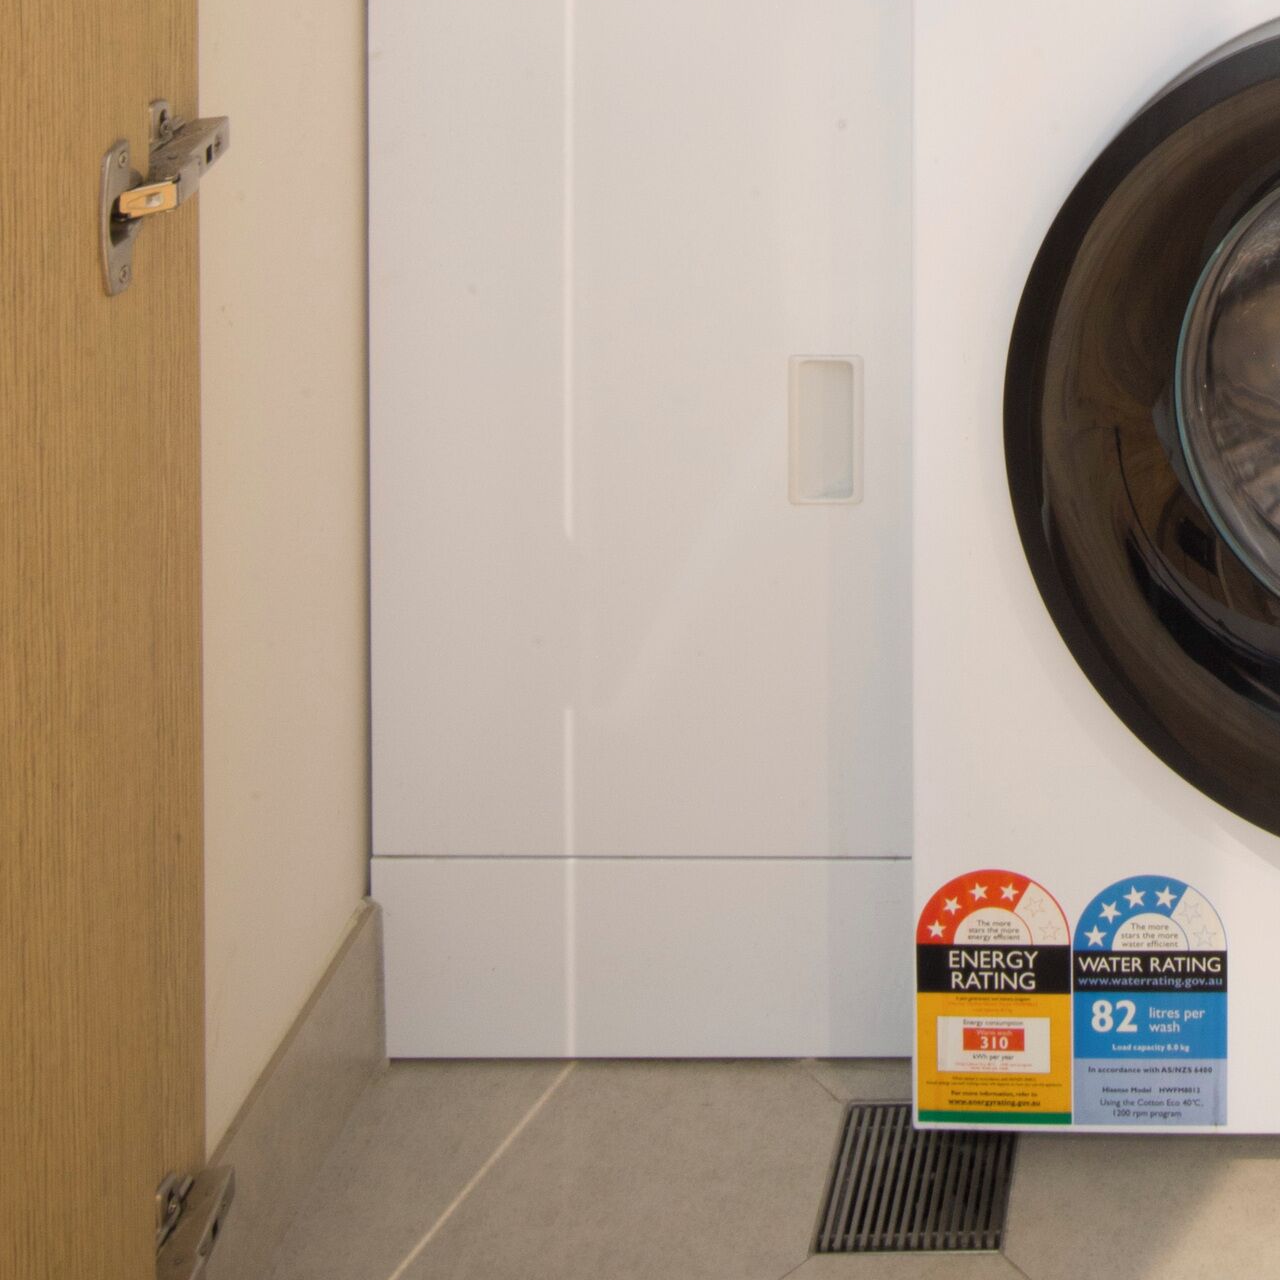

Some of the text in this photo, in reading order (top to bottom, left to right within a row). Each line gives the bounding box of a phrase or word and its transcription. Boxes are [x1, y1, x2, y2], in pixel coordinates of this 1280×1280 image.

[949, 951, 1038, 969] ENERGY
[1079, 956, 1221, 972] WATER RATING
[952, 972, 1036, 990] RATING
[1078, 976, 1223, 988] www.waterrating.gov.au
[1091, 1000, 1138, 1033] 82
[1149, 1007, 1206, 1021] litres per
[1149, 1022, 1180, 1032] wash
[981, 1036, 1009, 1049] 310
